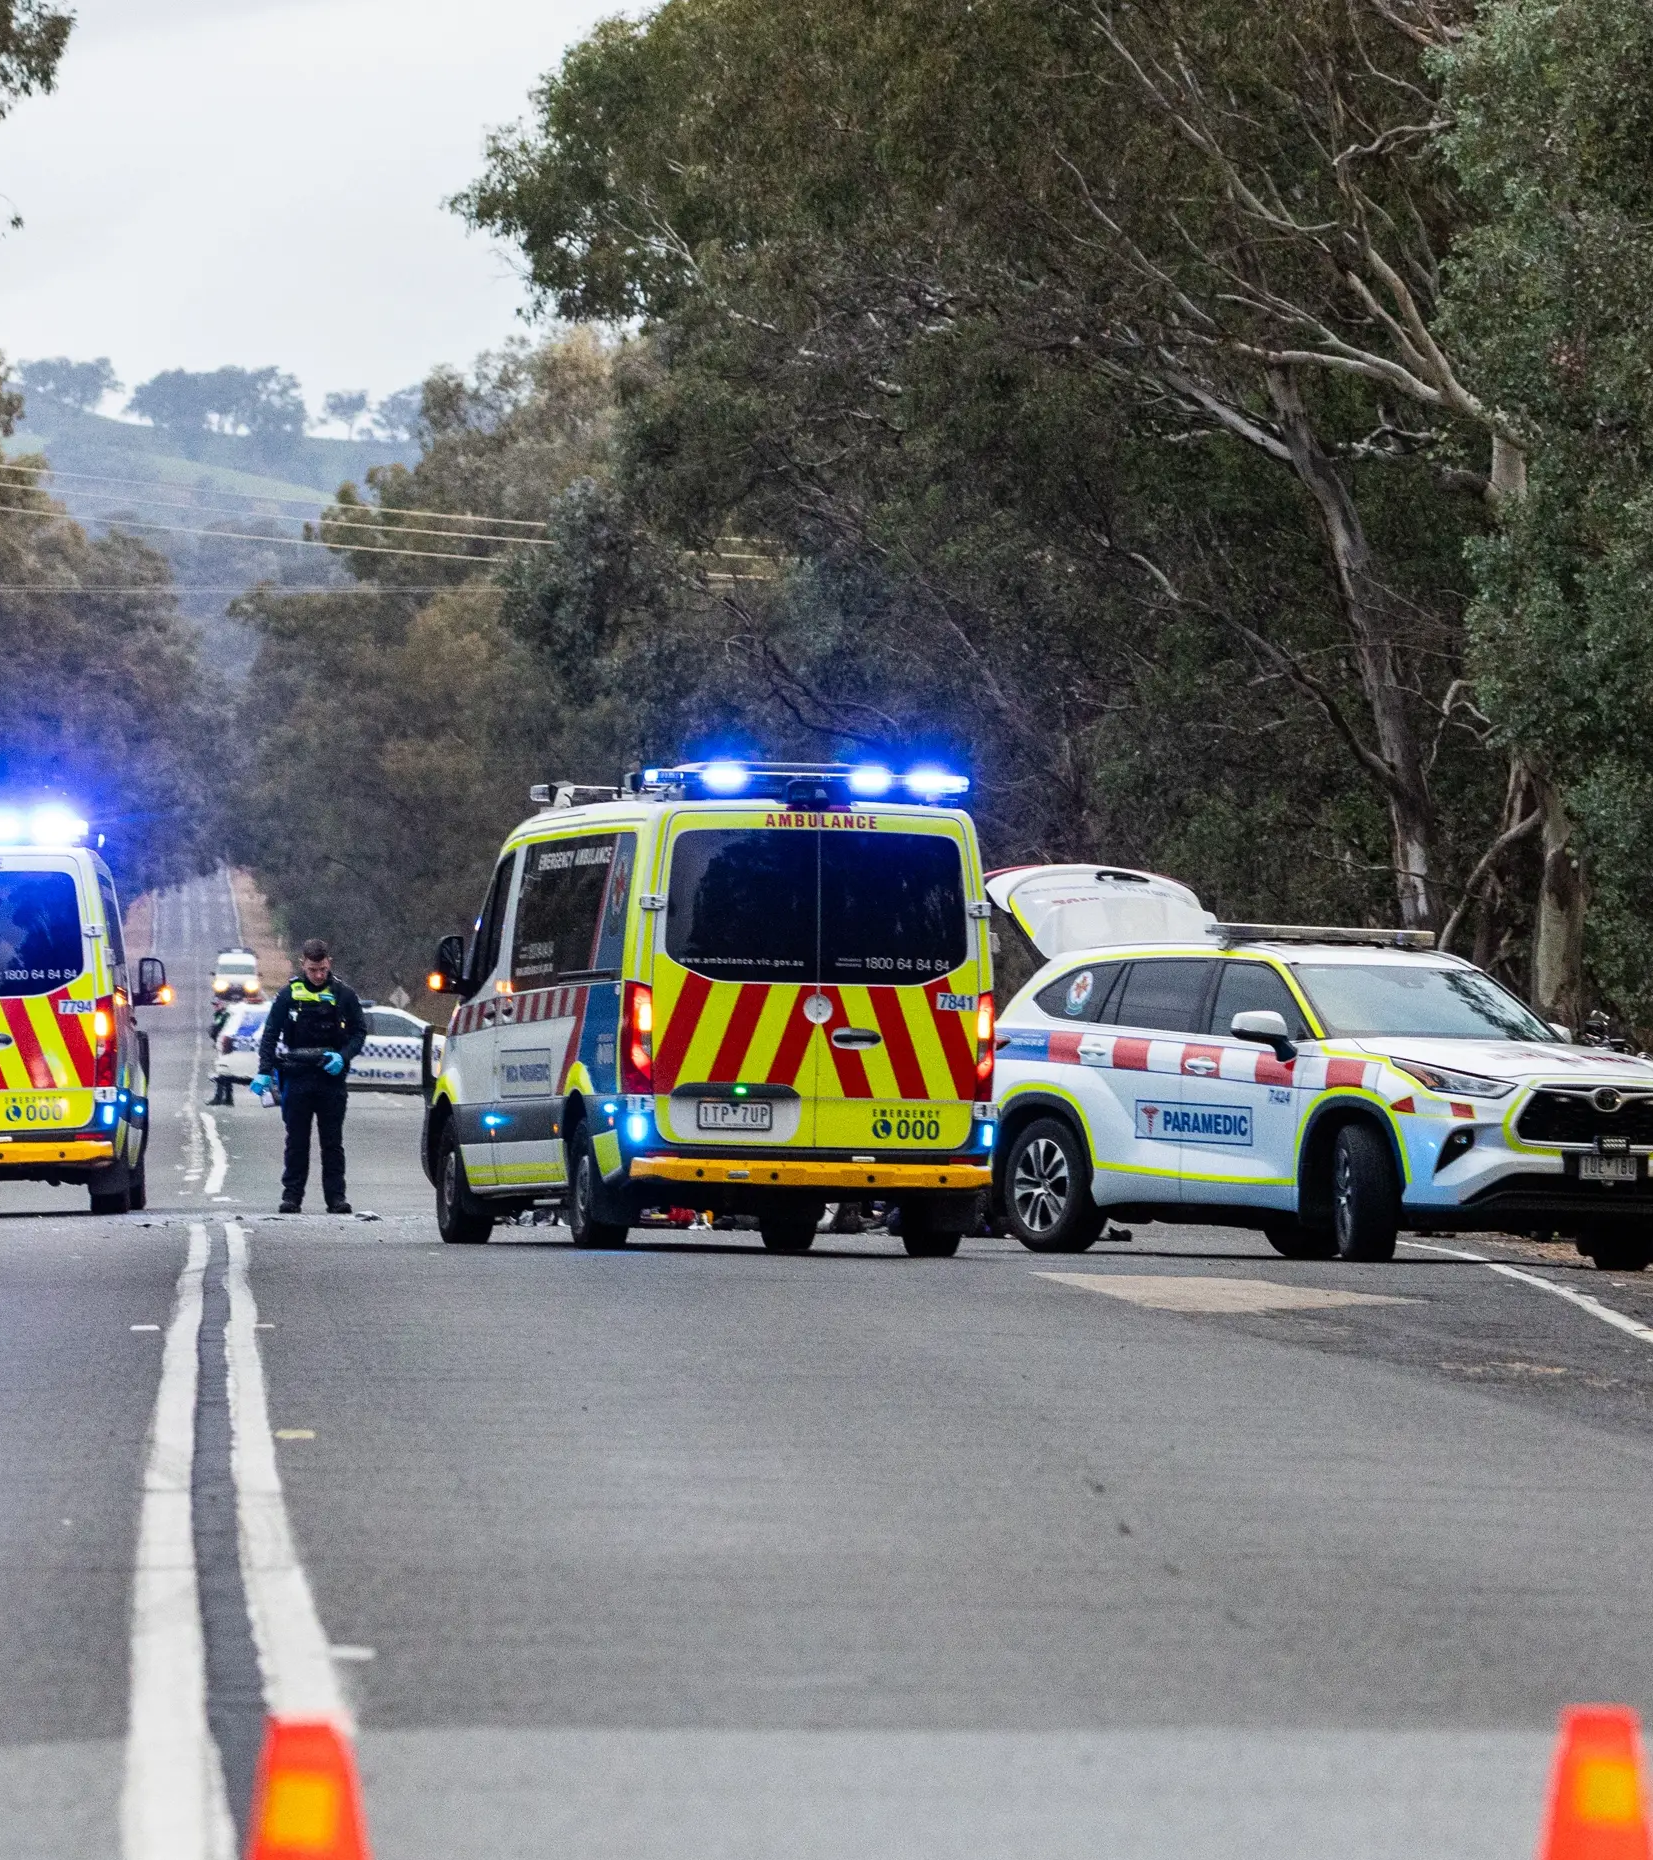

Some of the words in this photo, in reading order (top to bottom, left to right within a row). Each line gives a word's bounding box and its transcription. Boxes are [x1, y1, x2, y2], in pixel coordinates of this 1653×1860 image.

[766, 813, 878, 830] AMBULANCE
[679, 956, 805, 968] www.ambulance.vic.gov.au
[866, 957, 894, 970] 1800
[897, 958, 913, 970] 64
[916, 959, 931, 971] 84
[934, 959, 950, 972] 84
[4, 969, 29, 980] 1800
[31, 969, 45, 980] 64
[47, 969, 61, 979] 84
[63, 968, 77, 978] 84
[61, 1000, 93, 1013] 7794
[939, 994, 973, 1010] 7841
[26, 1105, 63, 1121] 000
[872, 1109, 940, 1118] EMERGENCY
[897, 1119, 940, 1140] 000
[1163, 1111, 1248, 1136] PARAMEDIC
